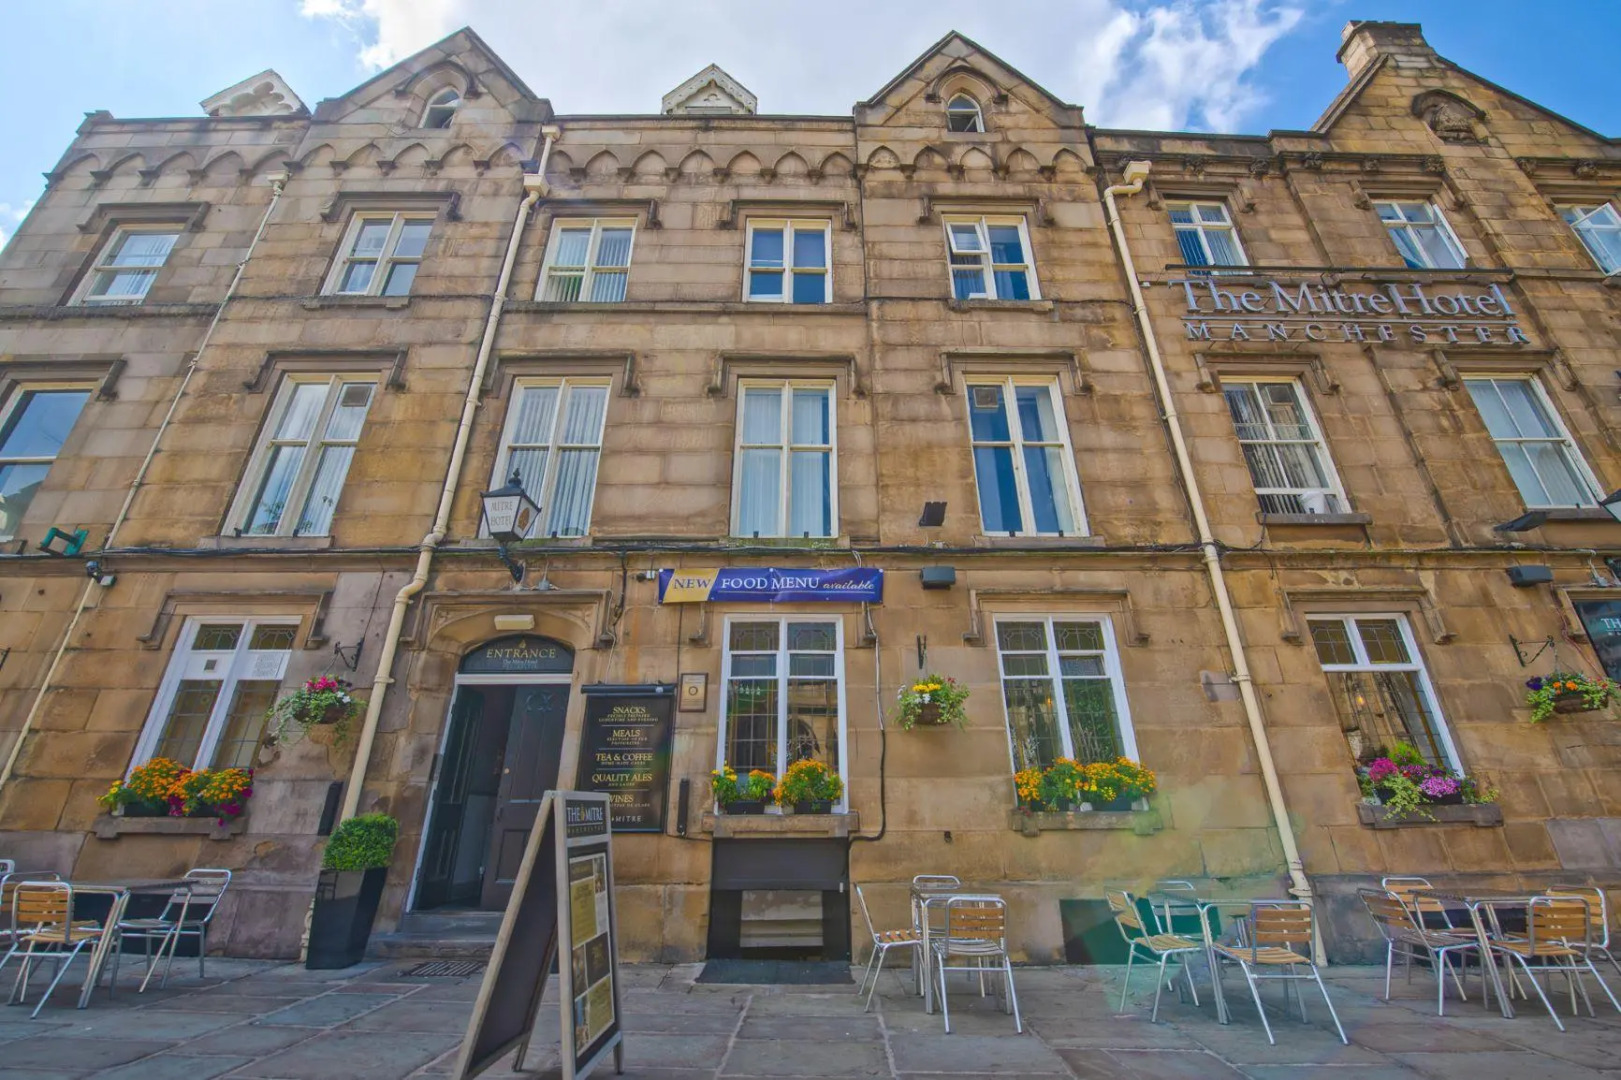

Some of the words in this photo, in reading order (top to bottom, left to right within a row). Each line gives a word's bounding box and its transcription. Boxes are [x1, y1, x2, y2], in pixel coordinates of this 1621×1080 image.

[1168, 278, 1265, 313] The
[1267, 281, 1394, 315] Mitre
[1383, 283, 1516, 317] Hotel
[1183, 322, 1531, 344] MANCHESTER
[490, 501, 513, 512] MITRE
[490, 515, 512, 527] HOTEL
[674, 578, 712, 589] NEW
[722, 577, 768, 589] FOOD
[770, 577, 820, 589] MENU
[822, 579, 875, 590] available
[486, 648, 556, 658] ENTRANCE
[612, 706, 646, 714] SNACKS
[612, 729, 641, 737] MEALS
[595, 753, 612, 761] TEA
[613, 753, 621, 761] &
[622, 753, 653, 761] COFFEE
[592, 773, 631, 783] QUALITY
[631, 773, 653, 782] ALES
[567, 807, 580, 822] THE
[585, 807, 604, 822] MITRE
